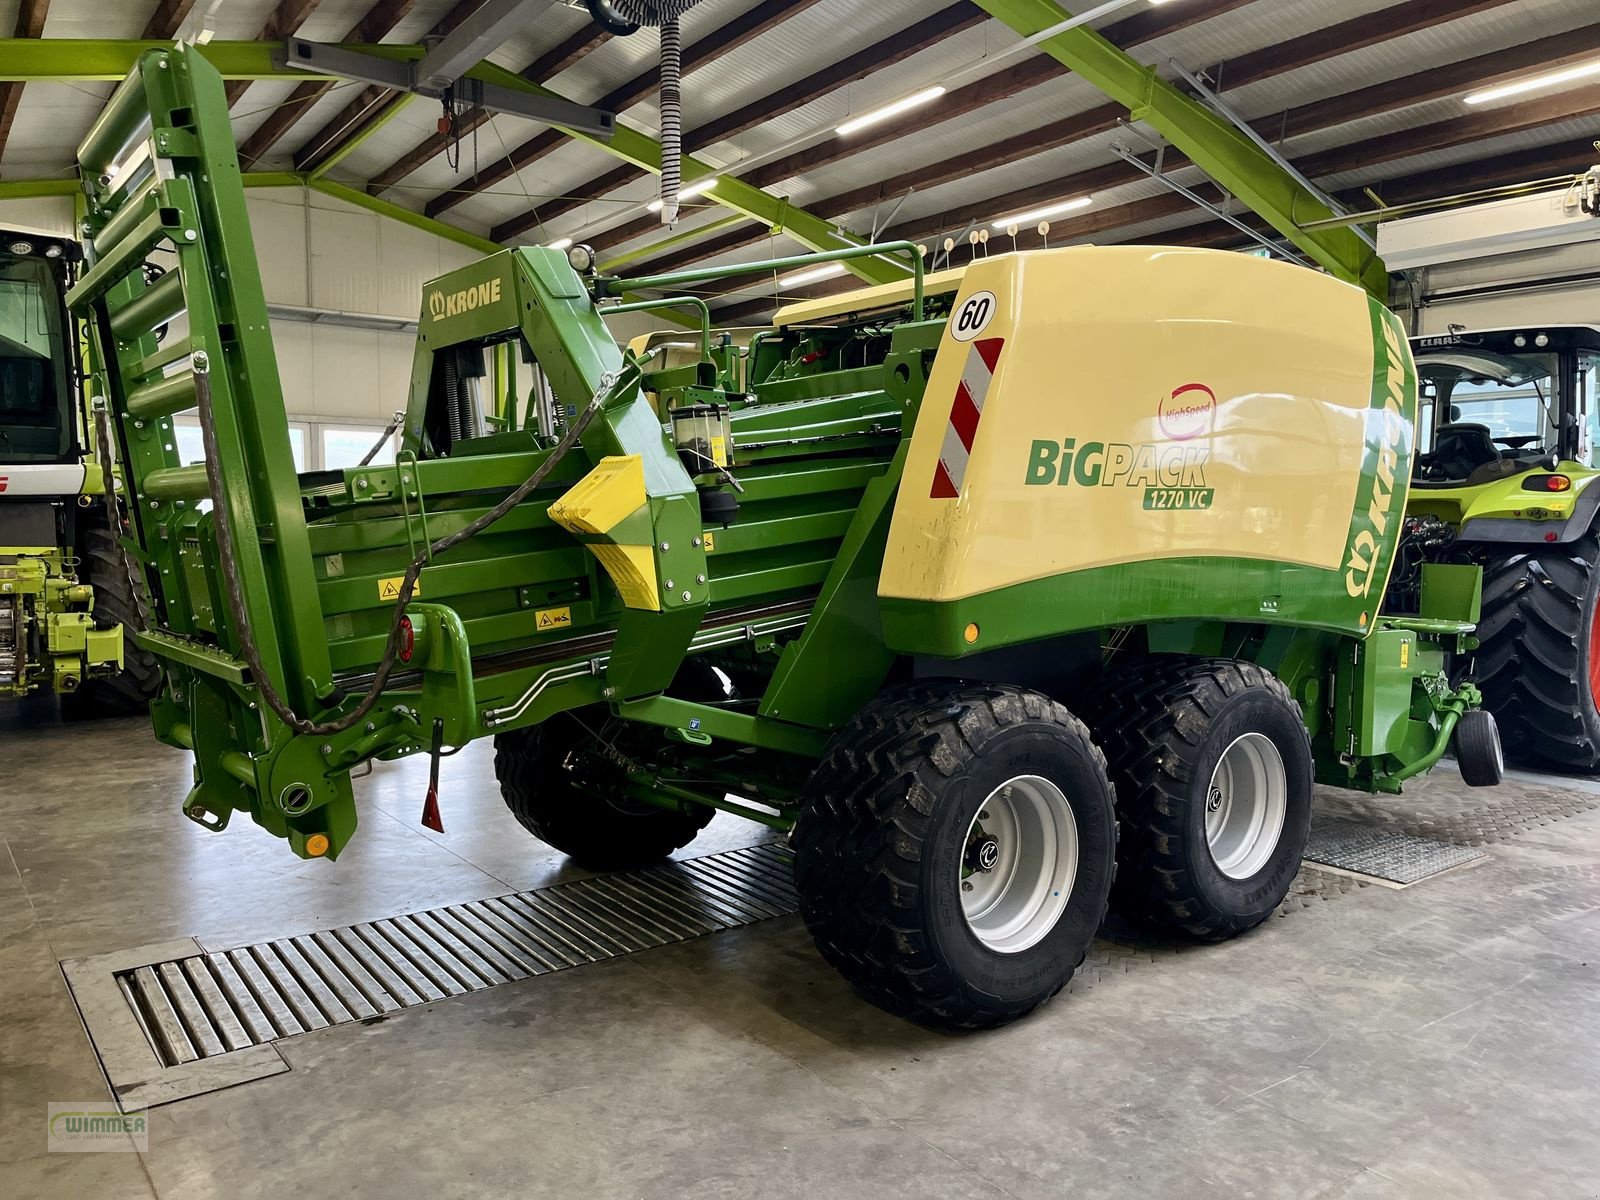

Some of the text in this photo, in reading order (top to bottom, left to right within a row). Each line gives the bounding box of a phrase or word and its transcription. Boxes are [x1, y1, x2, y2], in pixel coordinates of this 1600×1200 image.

[446, 278, 500, 317] KRONE
[958, 298, 990, 331] 60
[1420, 335, 1461, 347] CLAAS
[1166, 402, 1210, 421] HighSpeed
[1368, 313, 1404, 536] KRONE
[1151, 490, 1208, 508] 1270 VC
